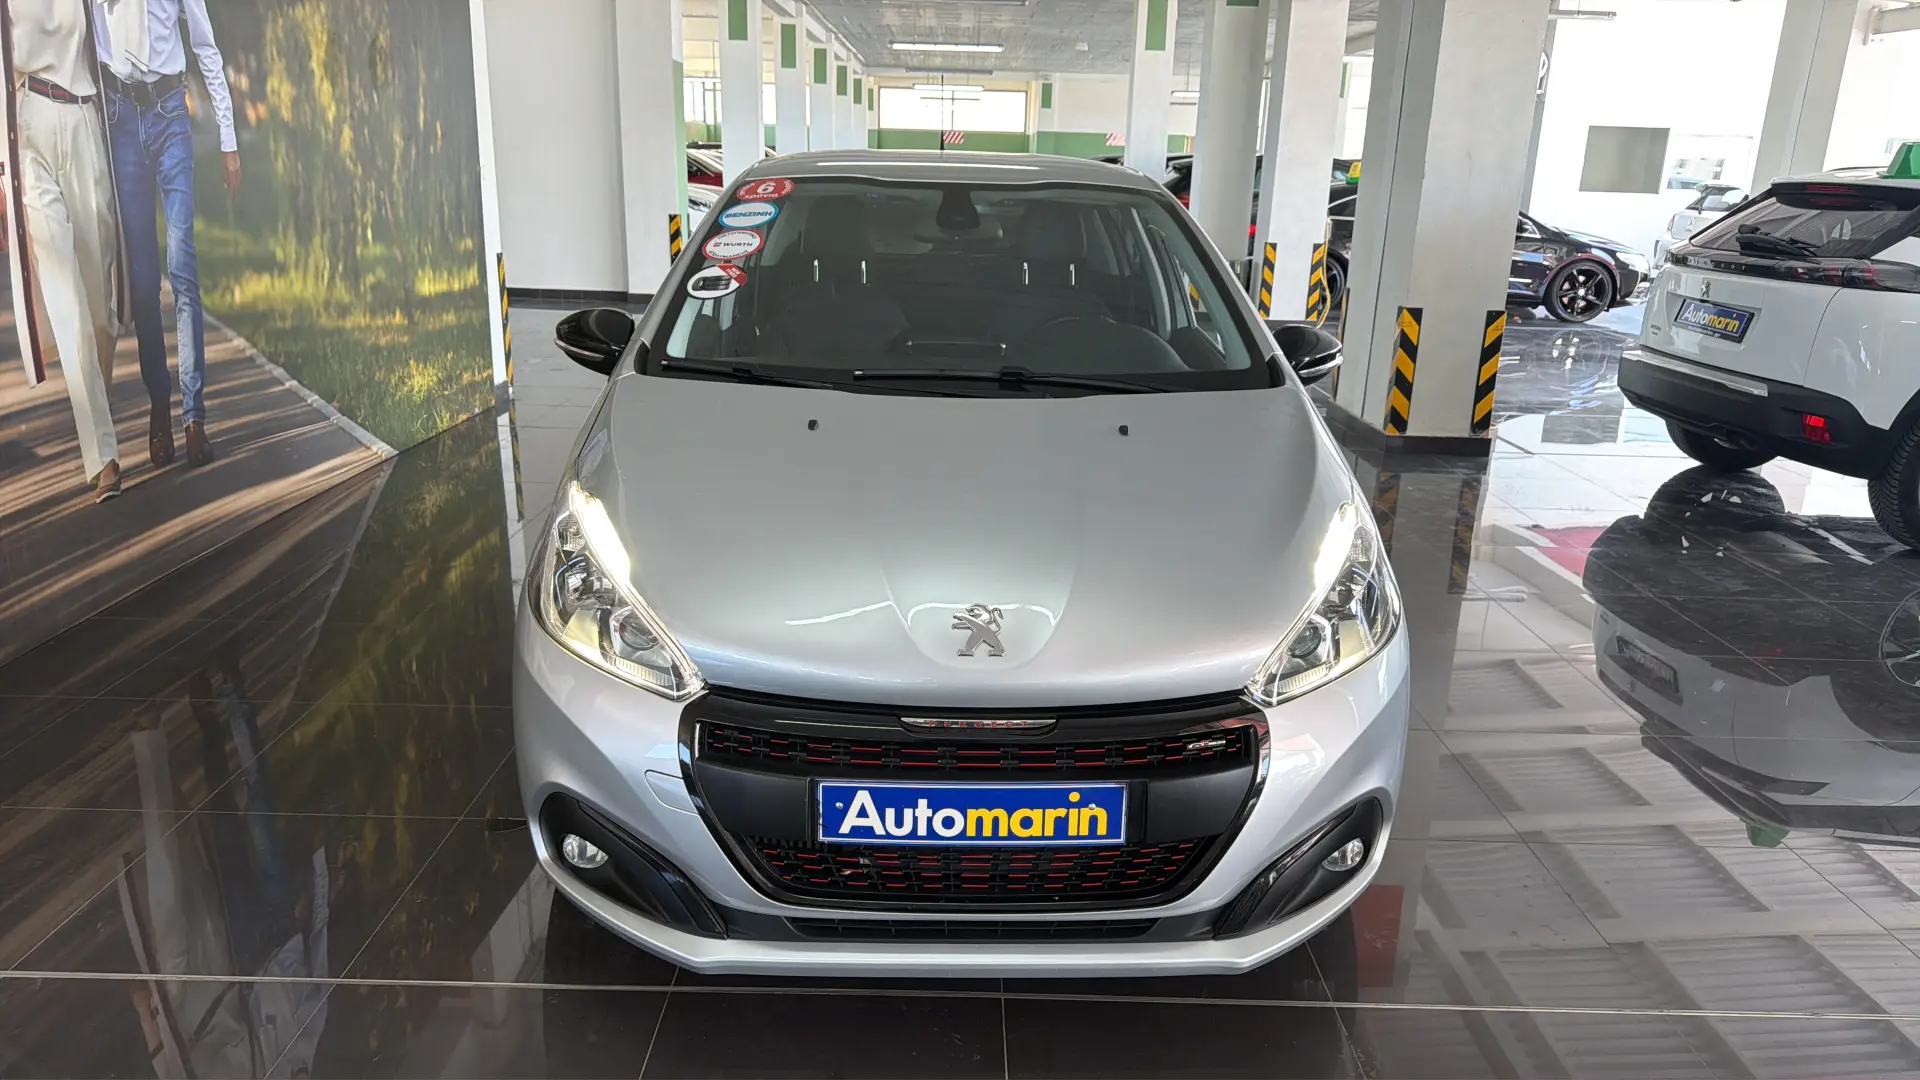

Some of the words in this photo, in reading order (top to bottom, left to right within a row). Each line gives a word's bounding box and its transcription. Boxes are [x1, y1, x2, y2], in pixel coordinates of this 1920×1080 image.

[757, 182, 776, 194] 6
[1681, 303, 1740, 333] Automarin
[928, 720, 1029, 729] PEUGEOT
[838, 789, 1108, 838] Automarin
